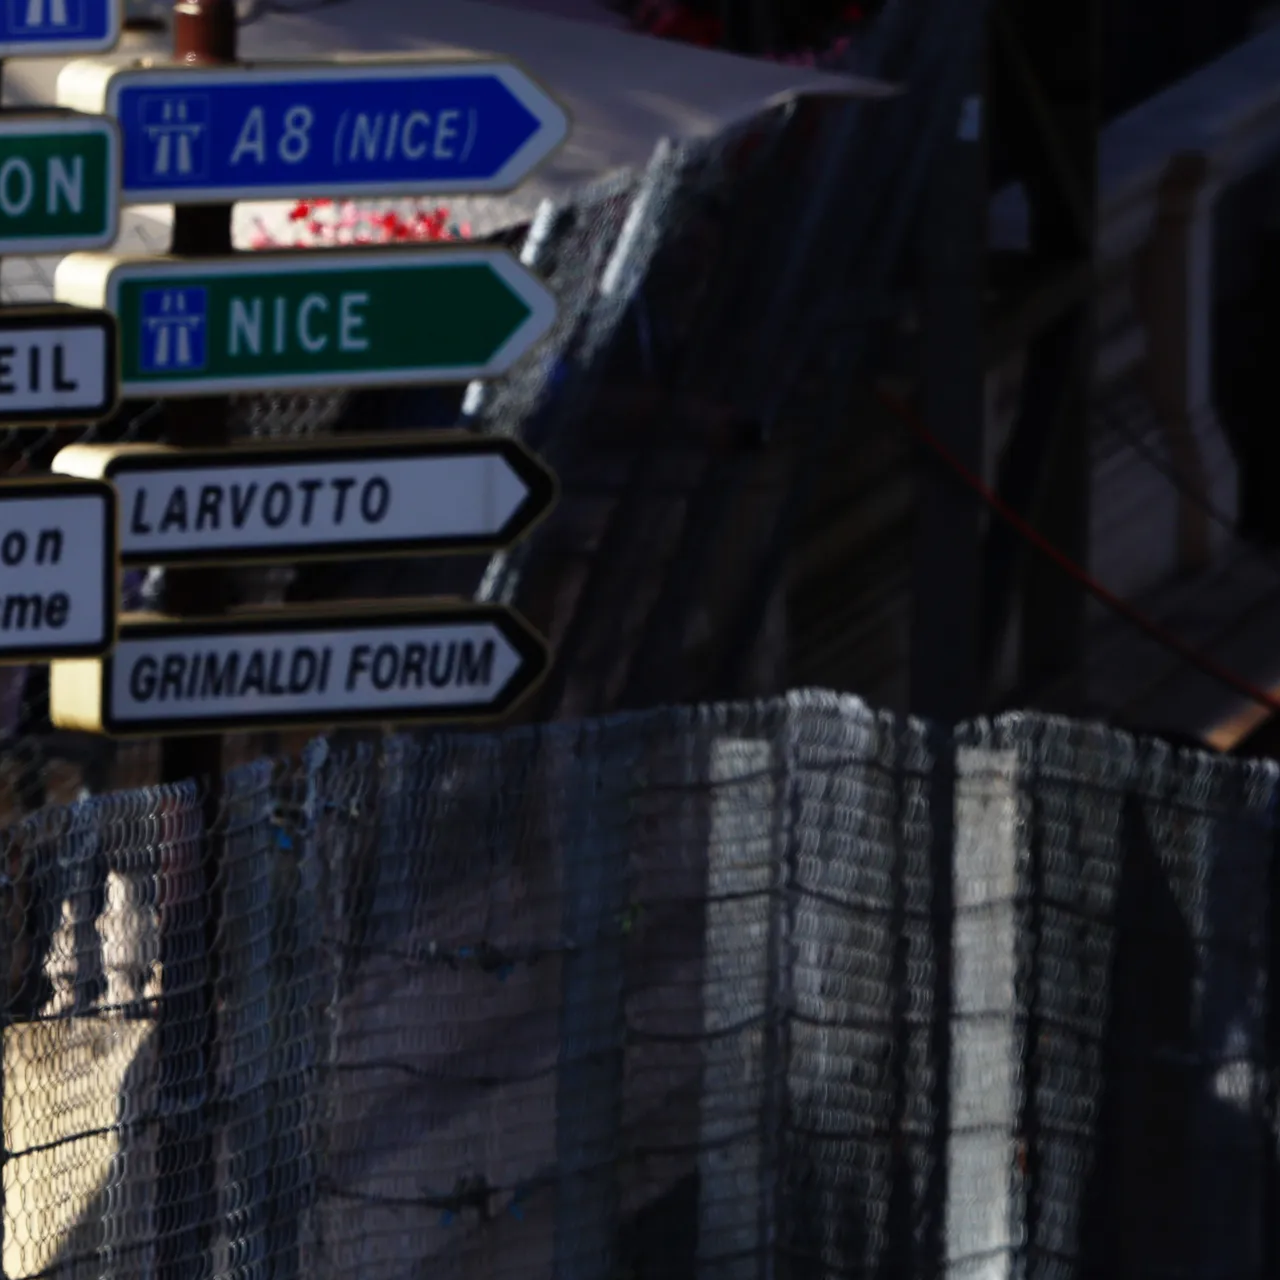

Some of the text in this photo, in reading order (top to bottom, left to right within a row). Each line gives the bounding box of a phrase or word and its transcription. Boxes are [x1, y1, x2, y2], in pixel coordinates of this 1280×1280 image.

[228, 104, 479, 168] A8 (NICE)
[226, 290, 372, 358] NICE
[129, 474, 392, 535] LARVOTTO
[129, 638, 496, 702] GRIMALDI FORUM
